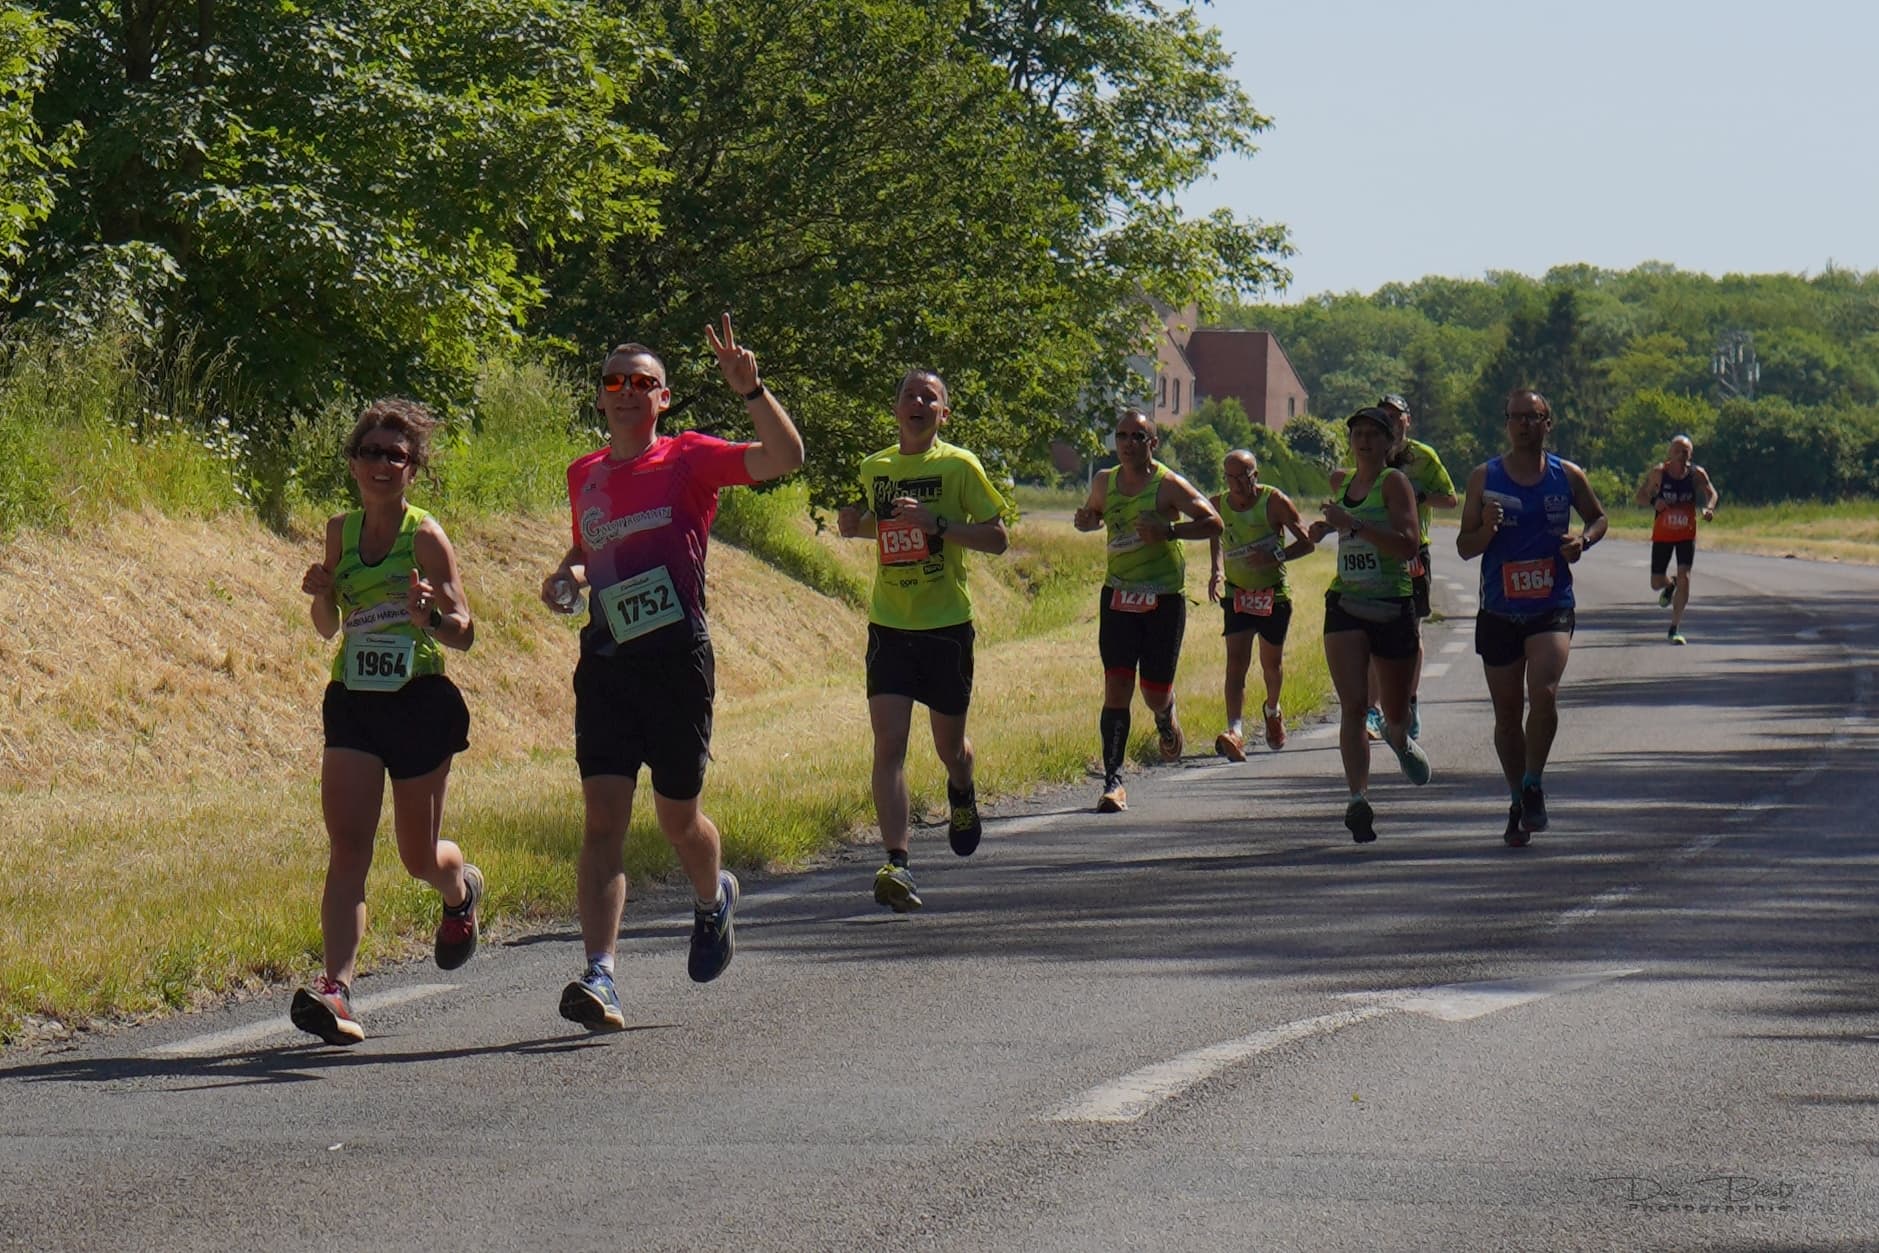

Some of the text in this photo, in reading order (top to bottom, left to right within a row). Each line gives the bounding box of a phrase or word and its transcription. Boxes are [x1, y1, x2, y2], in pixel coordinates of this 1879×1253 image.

[881, 528, 925, 553] 1359
[1343, 553, 1377, 571] 1985
[1511, 568, 1554, 592] 1364
[617, 585, 675, 625] 1752
[1240, 595, 1271, 609] 1252
[356, 651, 407, 678] 1964
